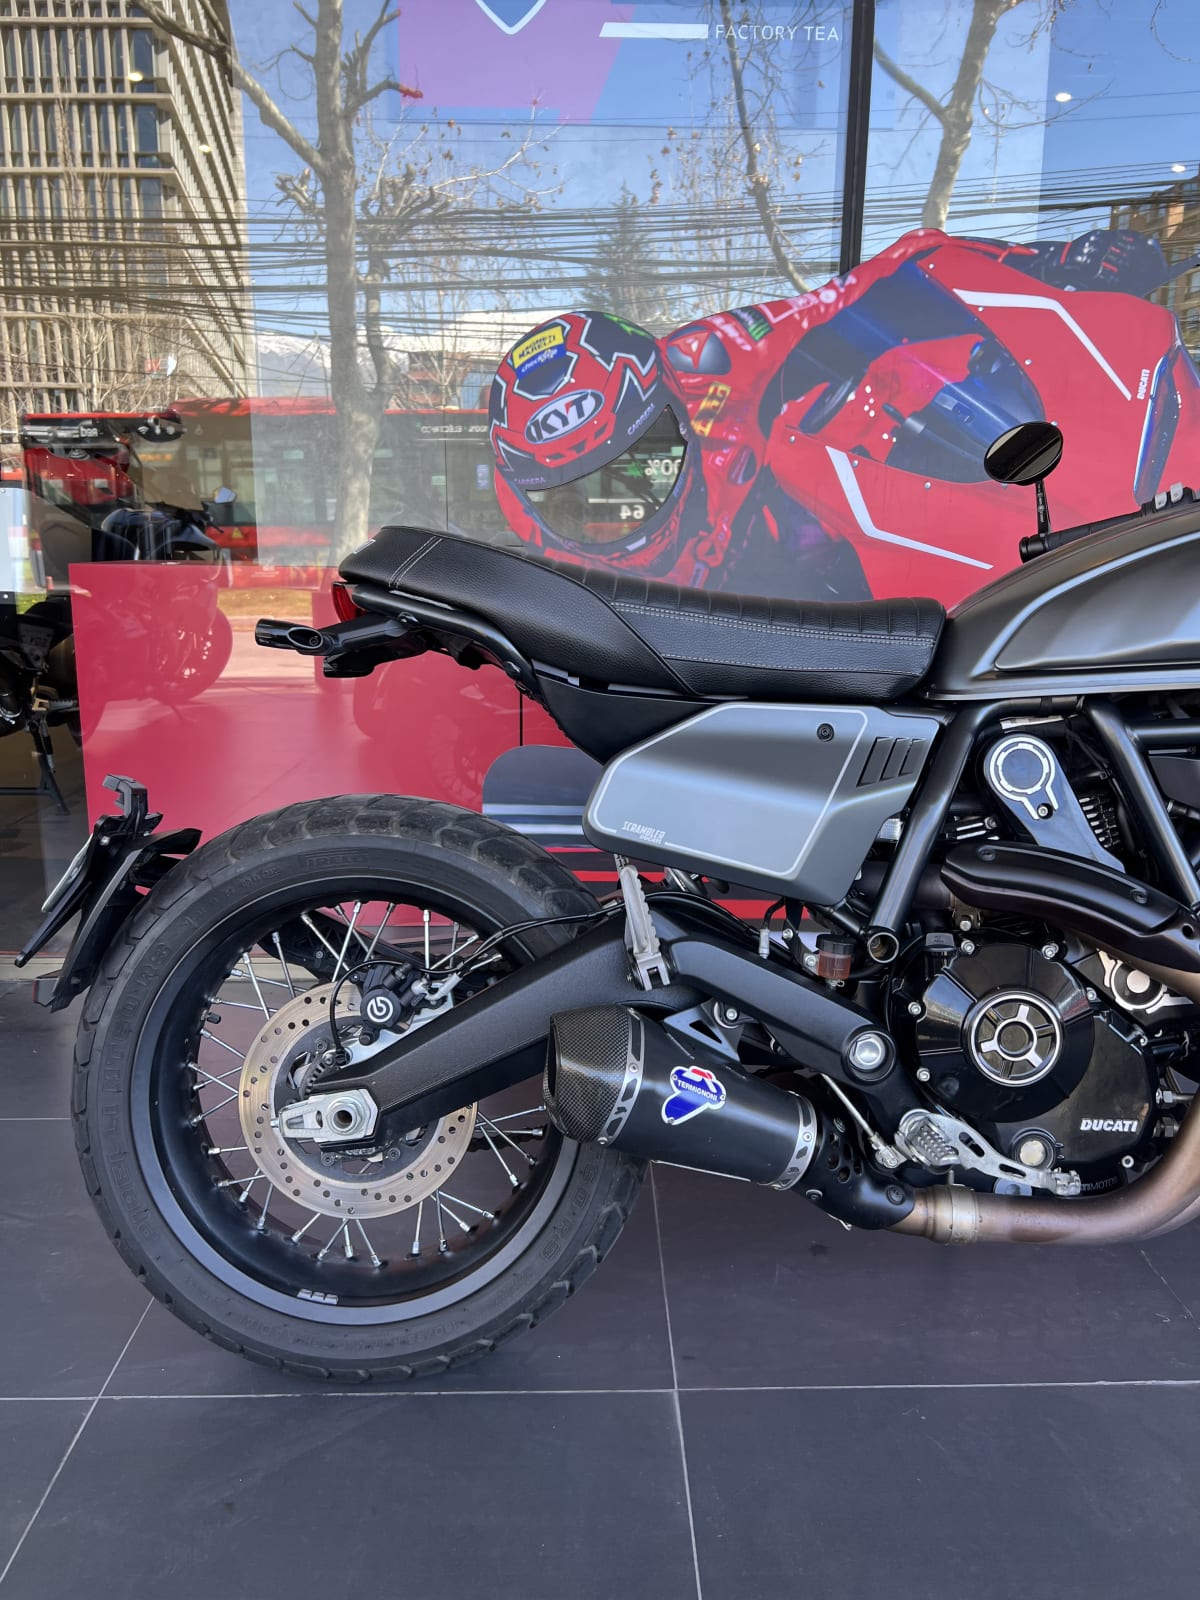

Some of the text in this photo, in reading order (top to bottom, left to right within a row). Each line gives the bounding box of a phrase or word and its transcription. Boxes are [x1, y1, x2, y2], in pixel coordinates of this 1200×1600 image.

[715, 24, 798, 41] FACTORY
[1136, 368, 1150, 400] DUCATI
[534, 391, 589, 441] KYT
[621, 820, 666, 840] SCRAMBLER
[677, 1079, 718, 1102] TERMIGNONI
[1080, 1118, 1138, 1133] DUCATI
